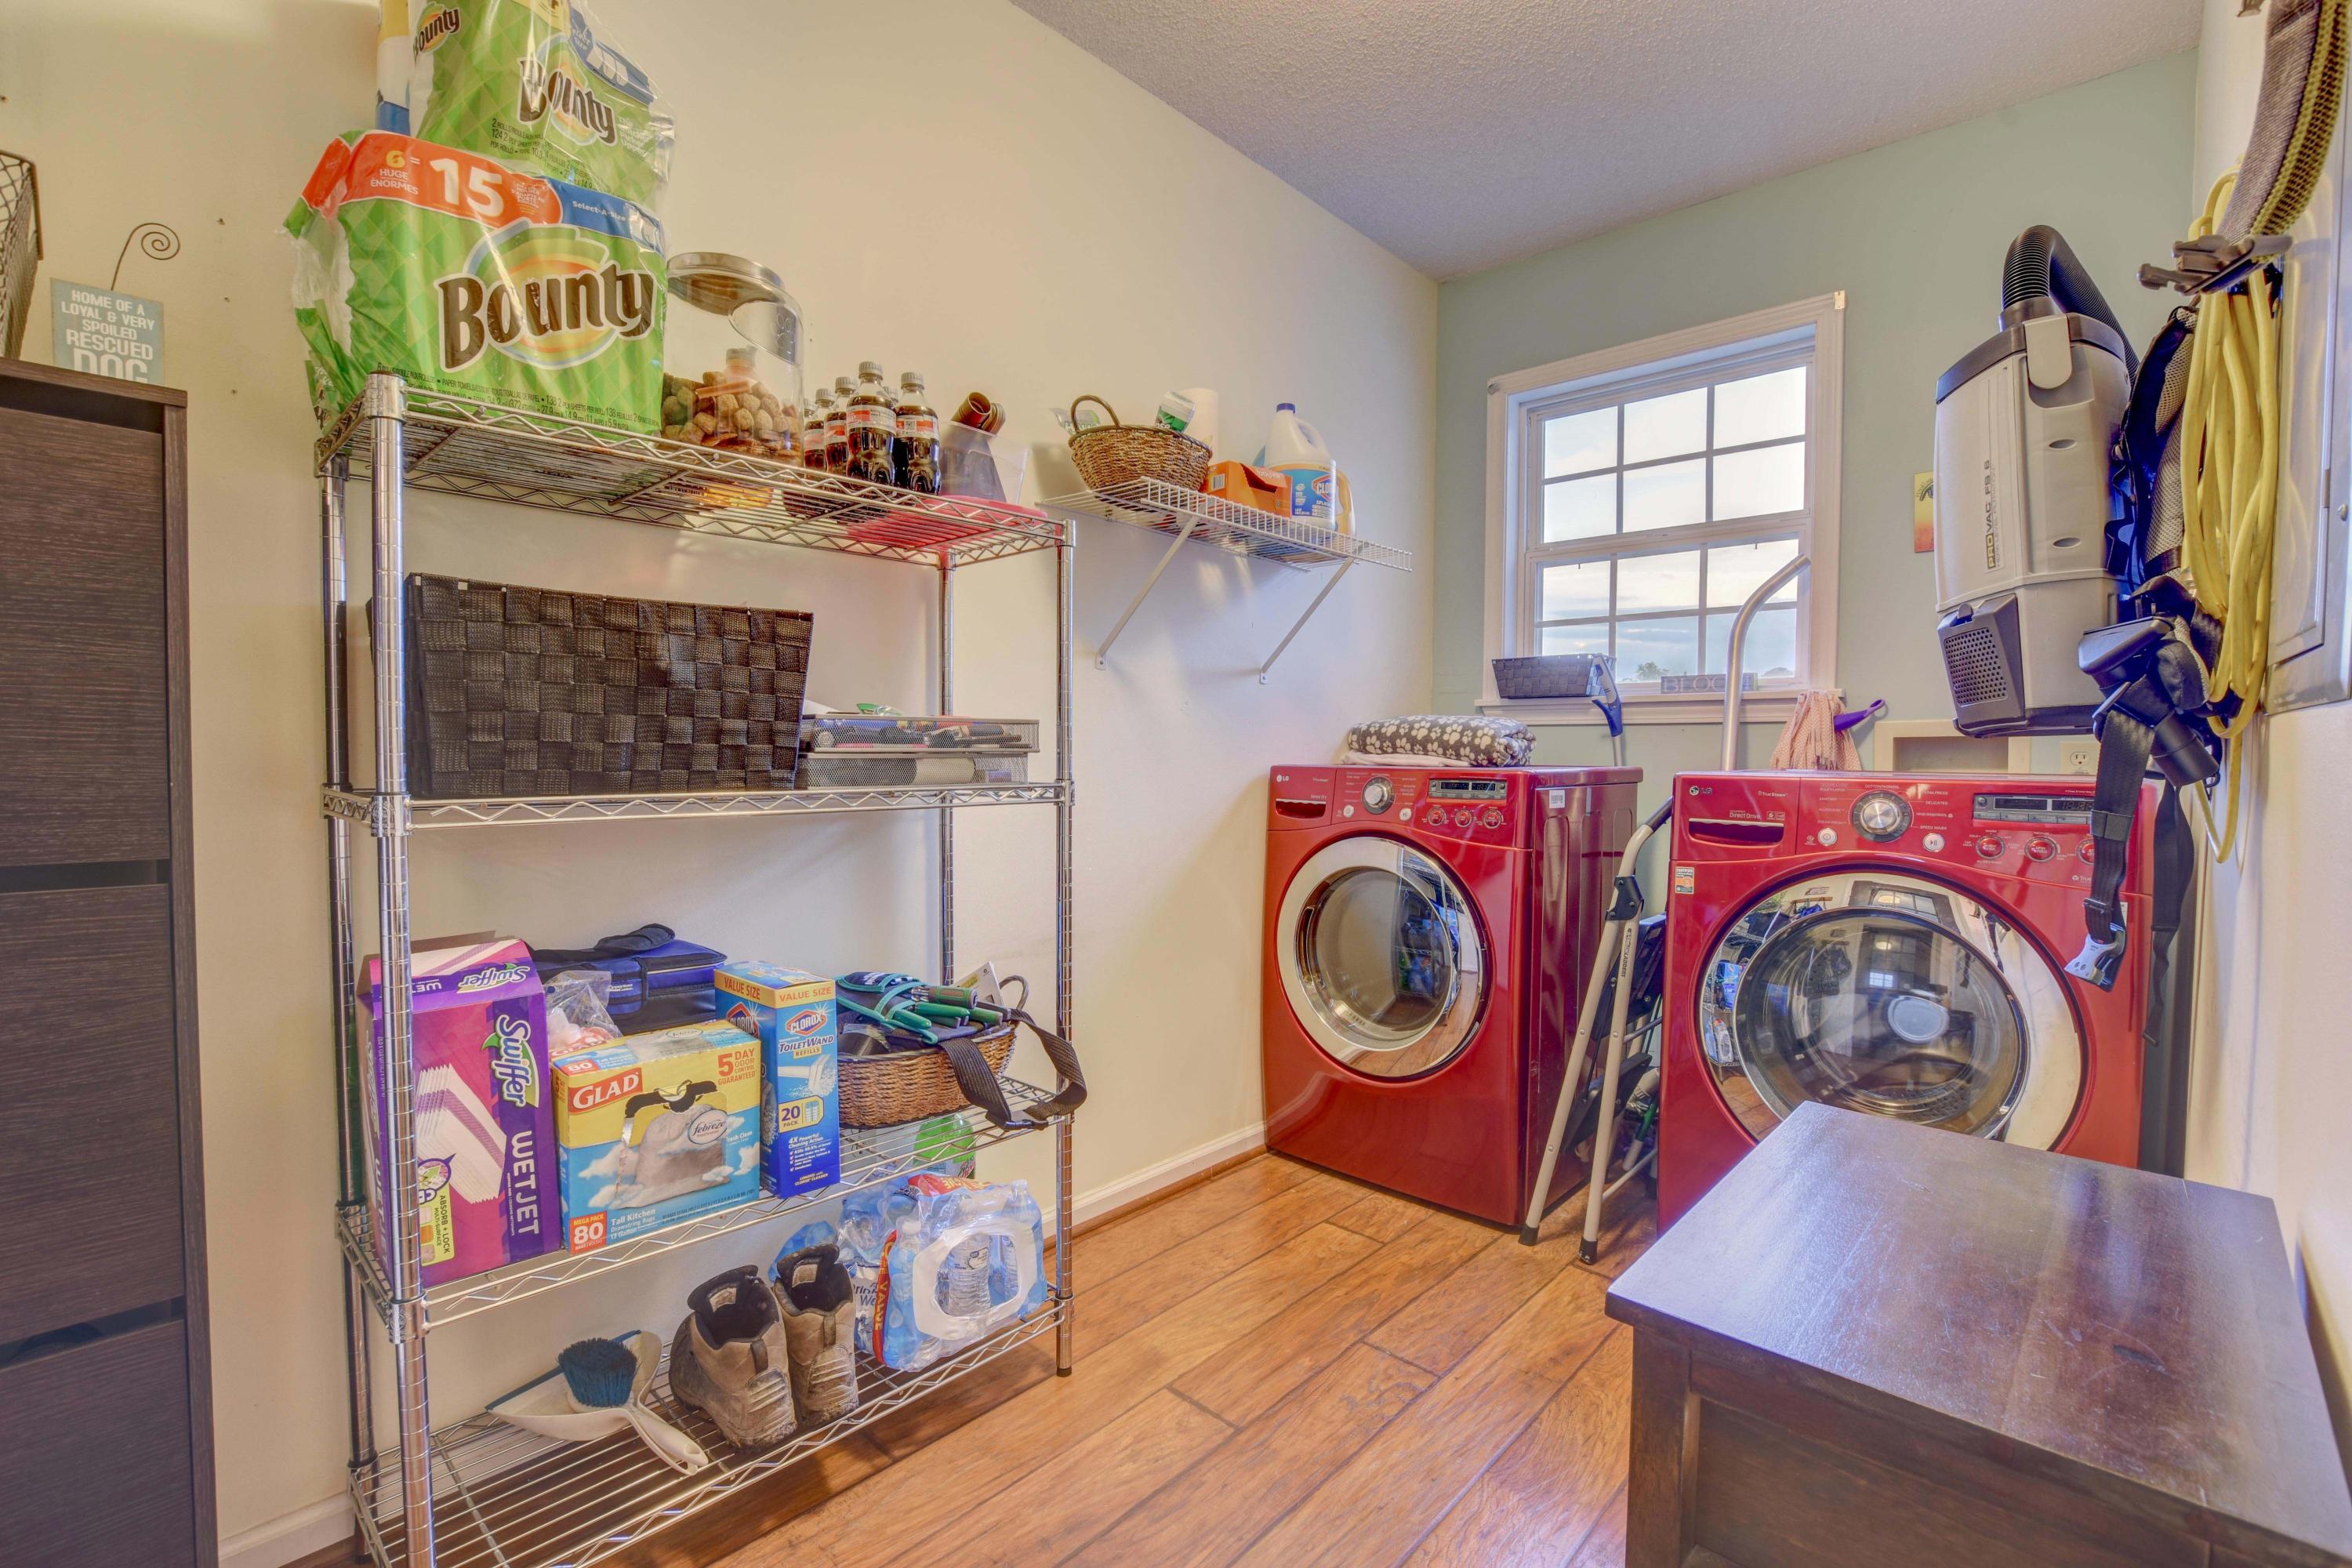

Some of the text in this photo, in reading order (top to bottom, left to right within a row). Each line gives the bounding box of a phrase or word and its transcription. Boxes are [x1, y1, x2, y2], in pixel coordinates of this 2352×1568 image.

[519, 60, 615, 145] Bounty
[492, 118, 497, 127] 2
[492, 129, 503, 139] 124
[379, 169, 408, 180] HUGE
[386, 150, 406, 168] 6
[430, 158, 504, 217] 15
[370, 179, 419, 195] ÉNORMES
[572, 201, 626, 221] Select-A-Size
[71, 289, 145, 315] HOME OF A
[61, 301, 155, 331] LOYAL & VERY
[437, 265, 655, 369] Bounty
[82, 319, 137, 341] SPOILED
[65, 328, 153, 361] RESCUED
[73, 348, 148, 384] DOG
[546, 394, 557, 405] 138
[1985, 475, 1991, 495] FS
[1664, 675, 1750, 691] BLOO
[459, 966, 530, 988] Swiffer
[724, 977, 760, 1000] VALUE SIZE
[779, 986, 832, 1002] VALUE SIZE
[790, 1013, 822, 1033] CLOROX
[492, 1014, 531, 1107] Swiffer
[718, 1047, 755, 1076] 5 DAY
[735, 1058, 754, 1067] ODOR
[795, 1048, 820, 1057] REFILLS
[568, 1062, 593, 1072] 80
[718, 1071, 756, 1085] GUARANTEED
[572, 1073, 639, 1109] GLAD
[781, 1105, 801, 1122] 20
[693, 1119, 726, 1136] febreze
[798, 1133, 819, 1142] Powerful
[789, 1141, 808, 1149] Cleaning
[511, 1131, 539, 1234] WETJET
[440, 1195, 448, 1225] ABSORB
[573, 1214, 604, 1226] MEGA PACK
[611, 1208, 656, 1226] Tall Kitchen
[574, 1223, 604, 1245] 80
[611, 1215, 656, 1233] Drawstring Bags
[442, 1232, 451, 1254] LOCK
